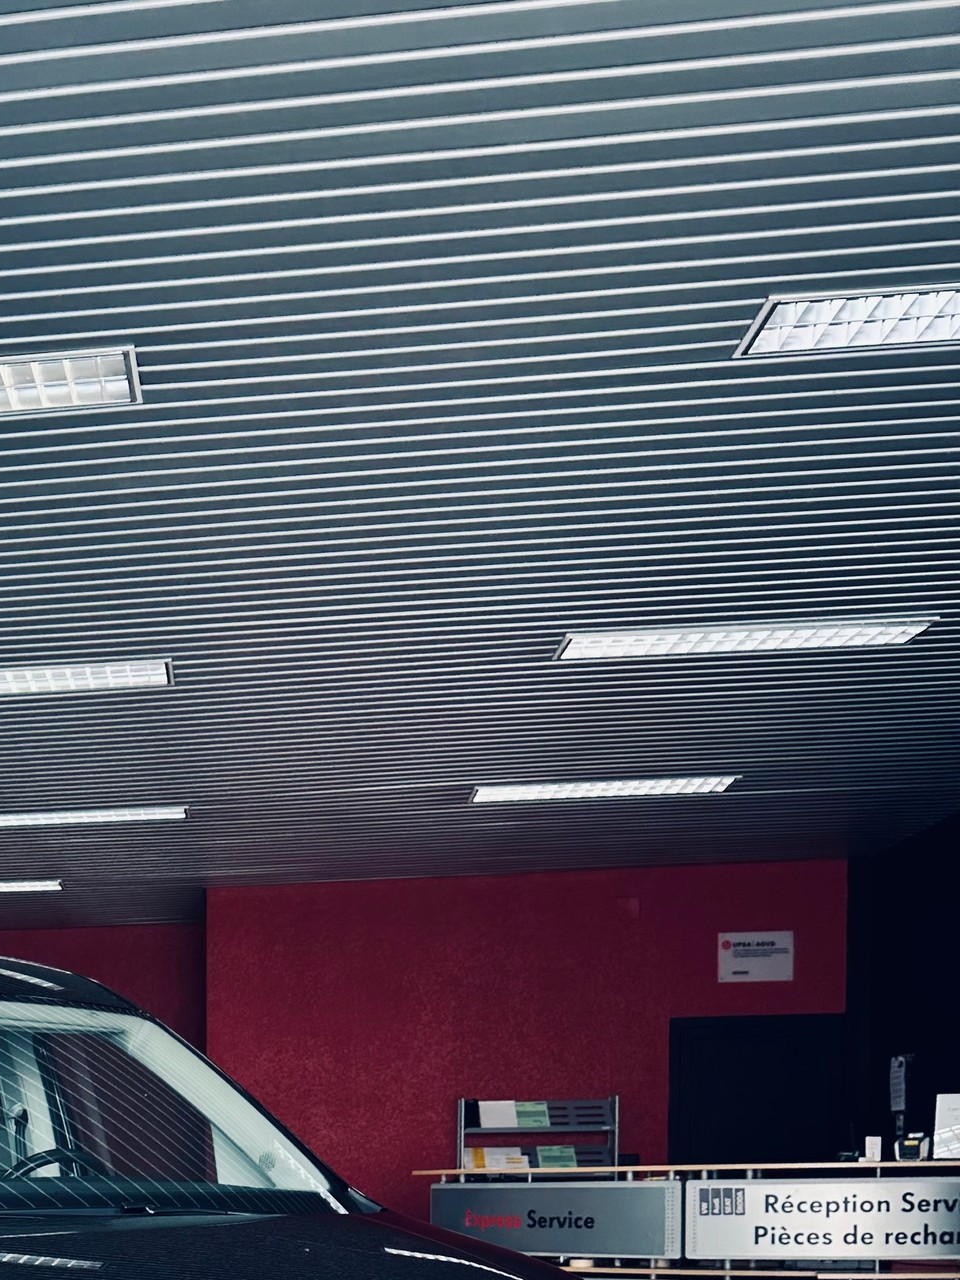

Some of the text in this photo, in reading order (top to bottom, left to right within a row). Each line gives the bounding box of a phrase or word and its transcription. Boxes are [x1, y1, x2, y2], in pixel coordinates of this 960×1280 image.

[765, 1191, 960, 1218] Réception Serv
[465, 1209, 595, 1231] Express Service
[754, 1226, 833, 1245] Pièces
[843, 1224, 874, 1245] de
